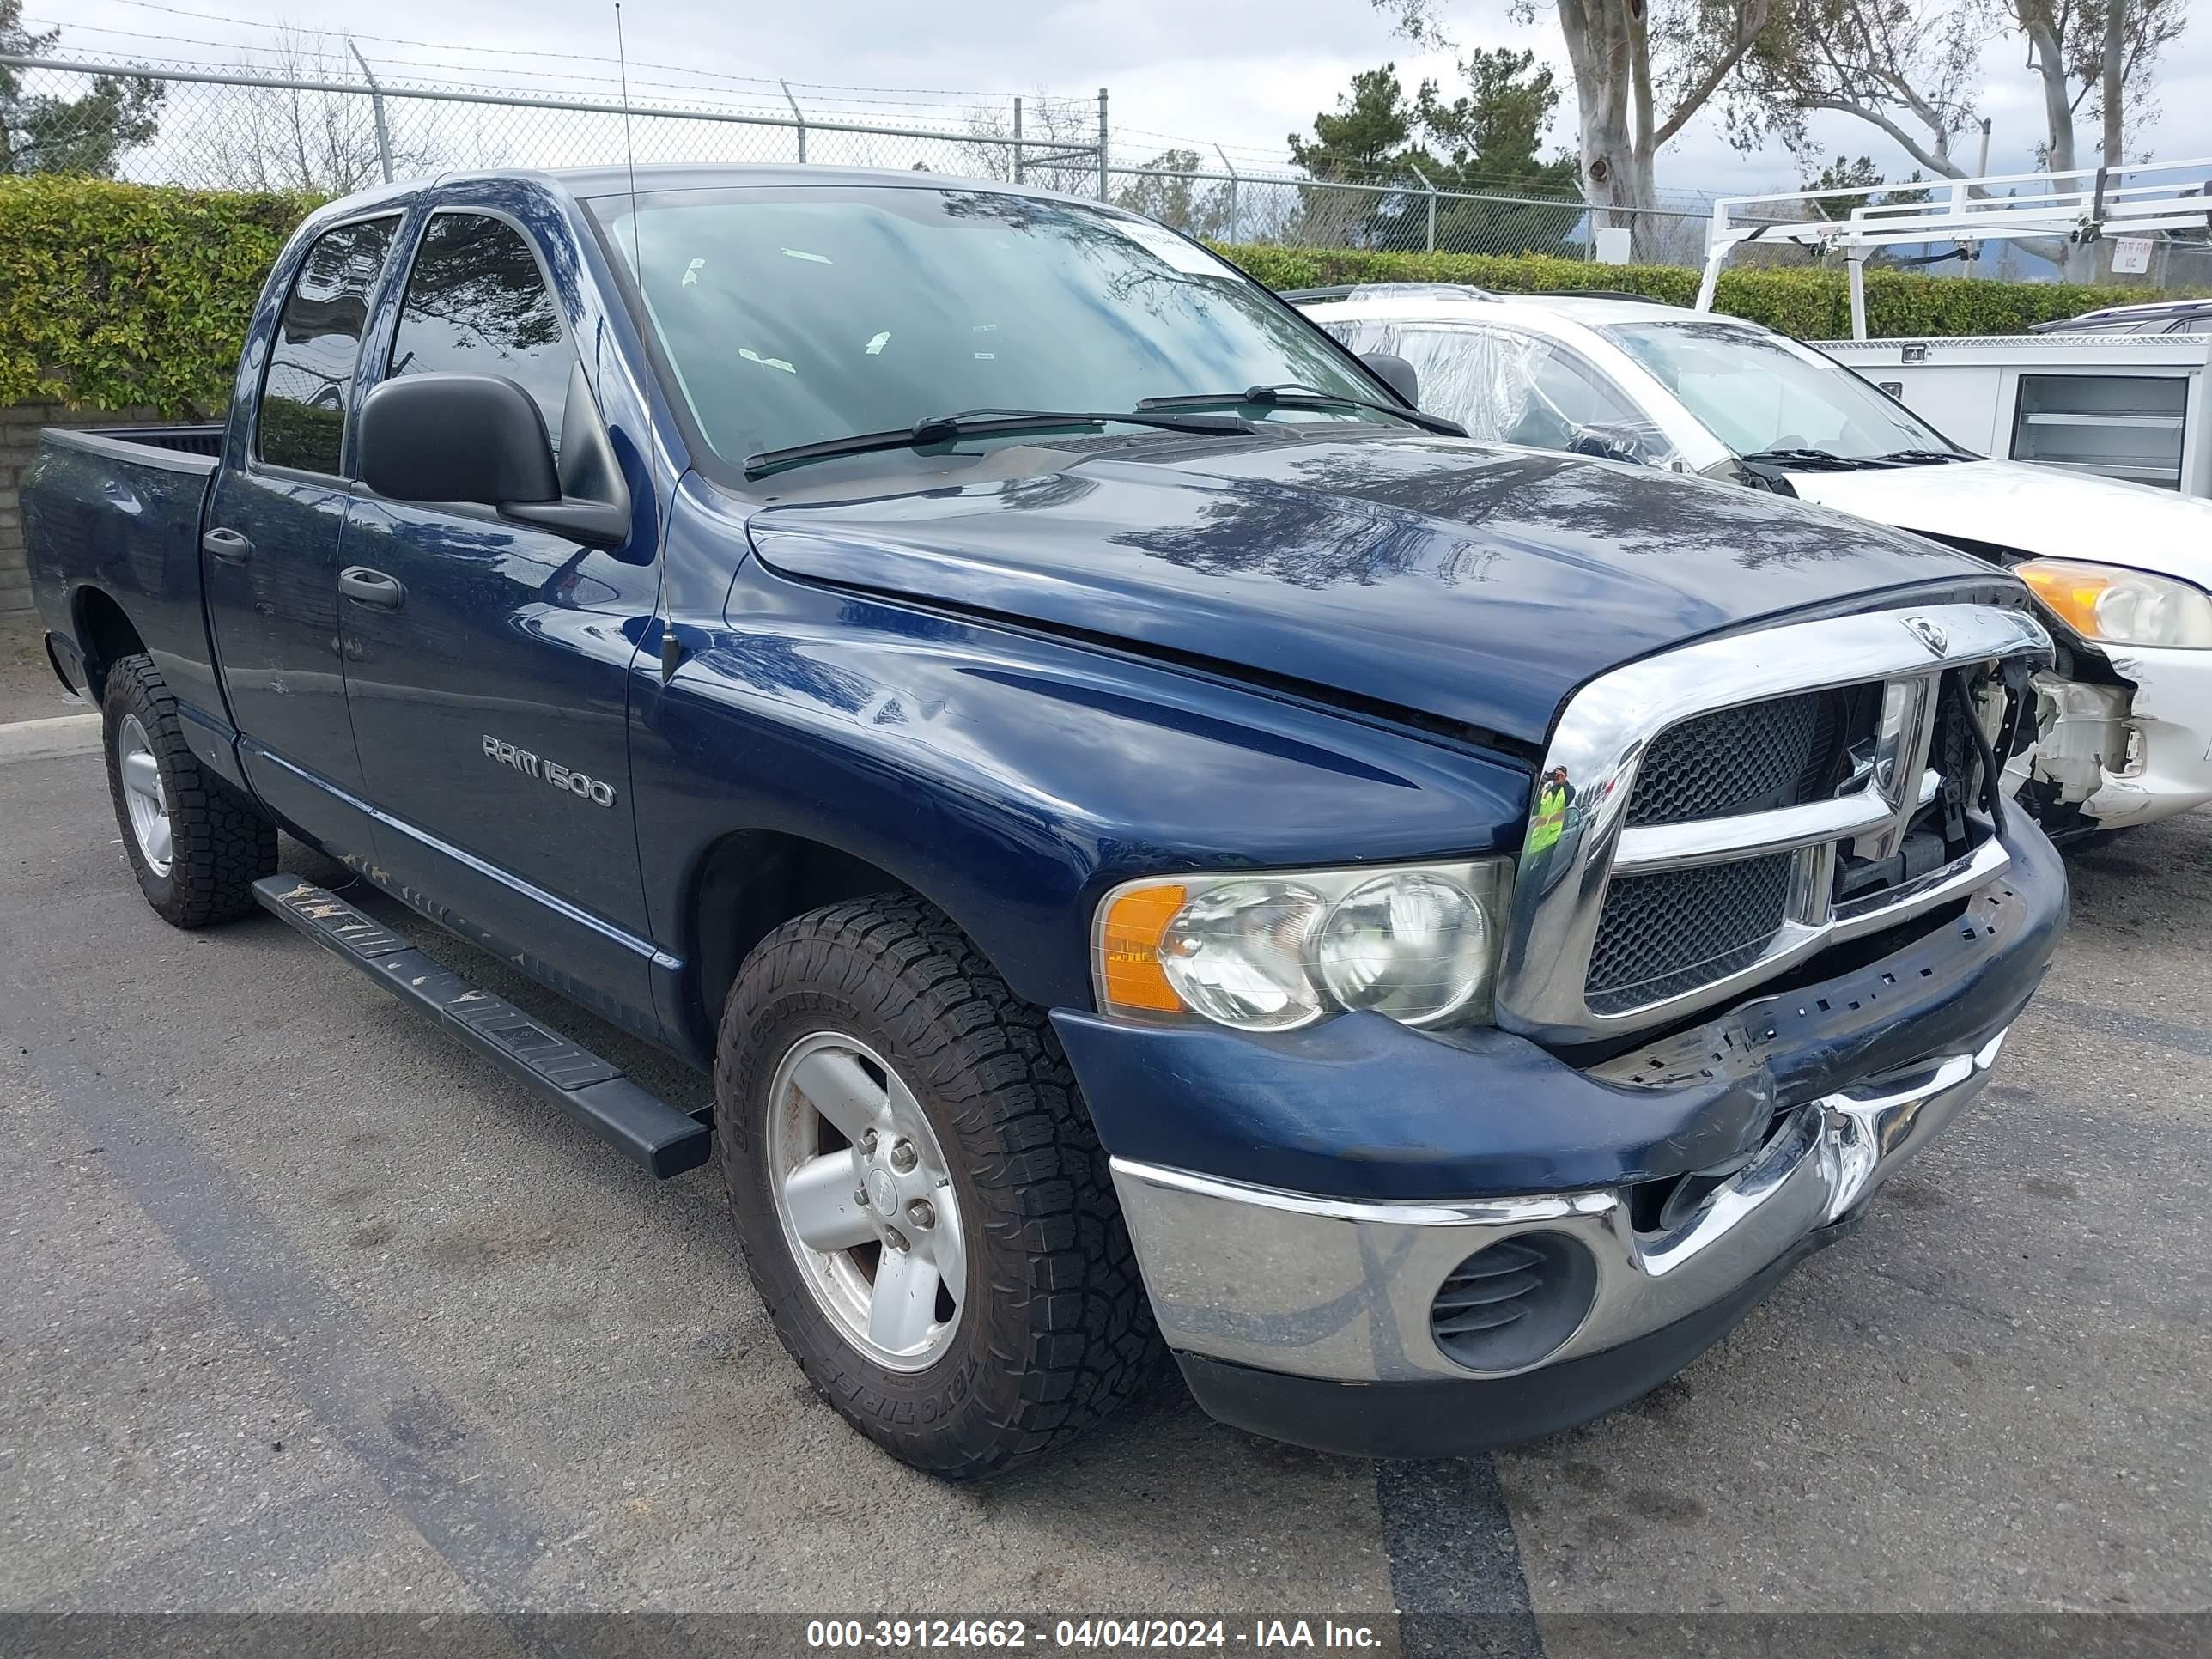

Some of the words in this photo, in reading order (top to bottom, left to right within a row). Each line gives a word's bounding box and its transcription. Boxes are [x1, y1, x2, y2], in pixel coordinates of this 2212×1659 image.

[2116, 241, 2135, 254] STATE
[482, 734, 541, 779] RAM
[542, 759, 617, 808] 1500
[750, 990, 860, 1047] COUNTRY
[817, 1358, 916, 1425] TIRES
[922, 1346, 979, 1424] TOYO
